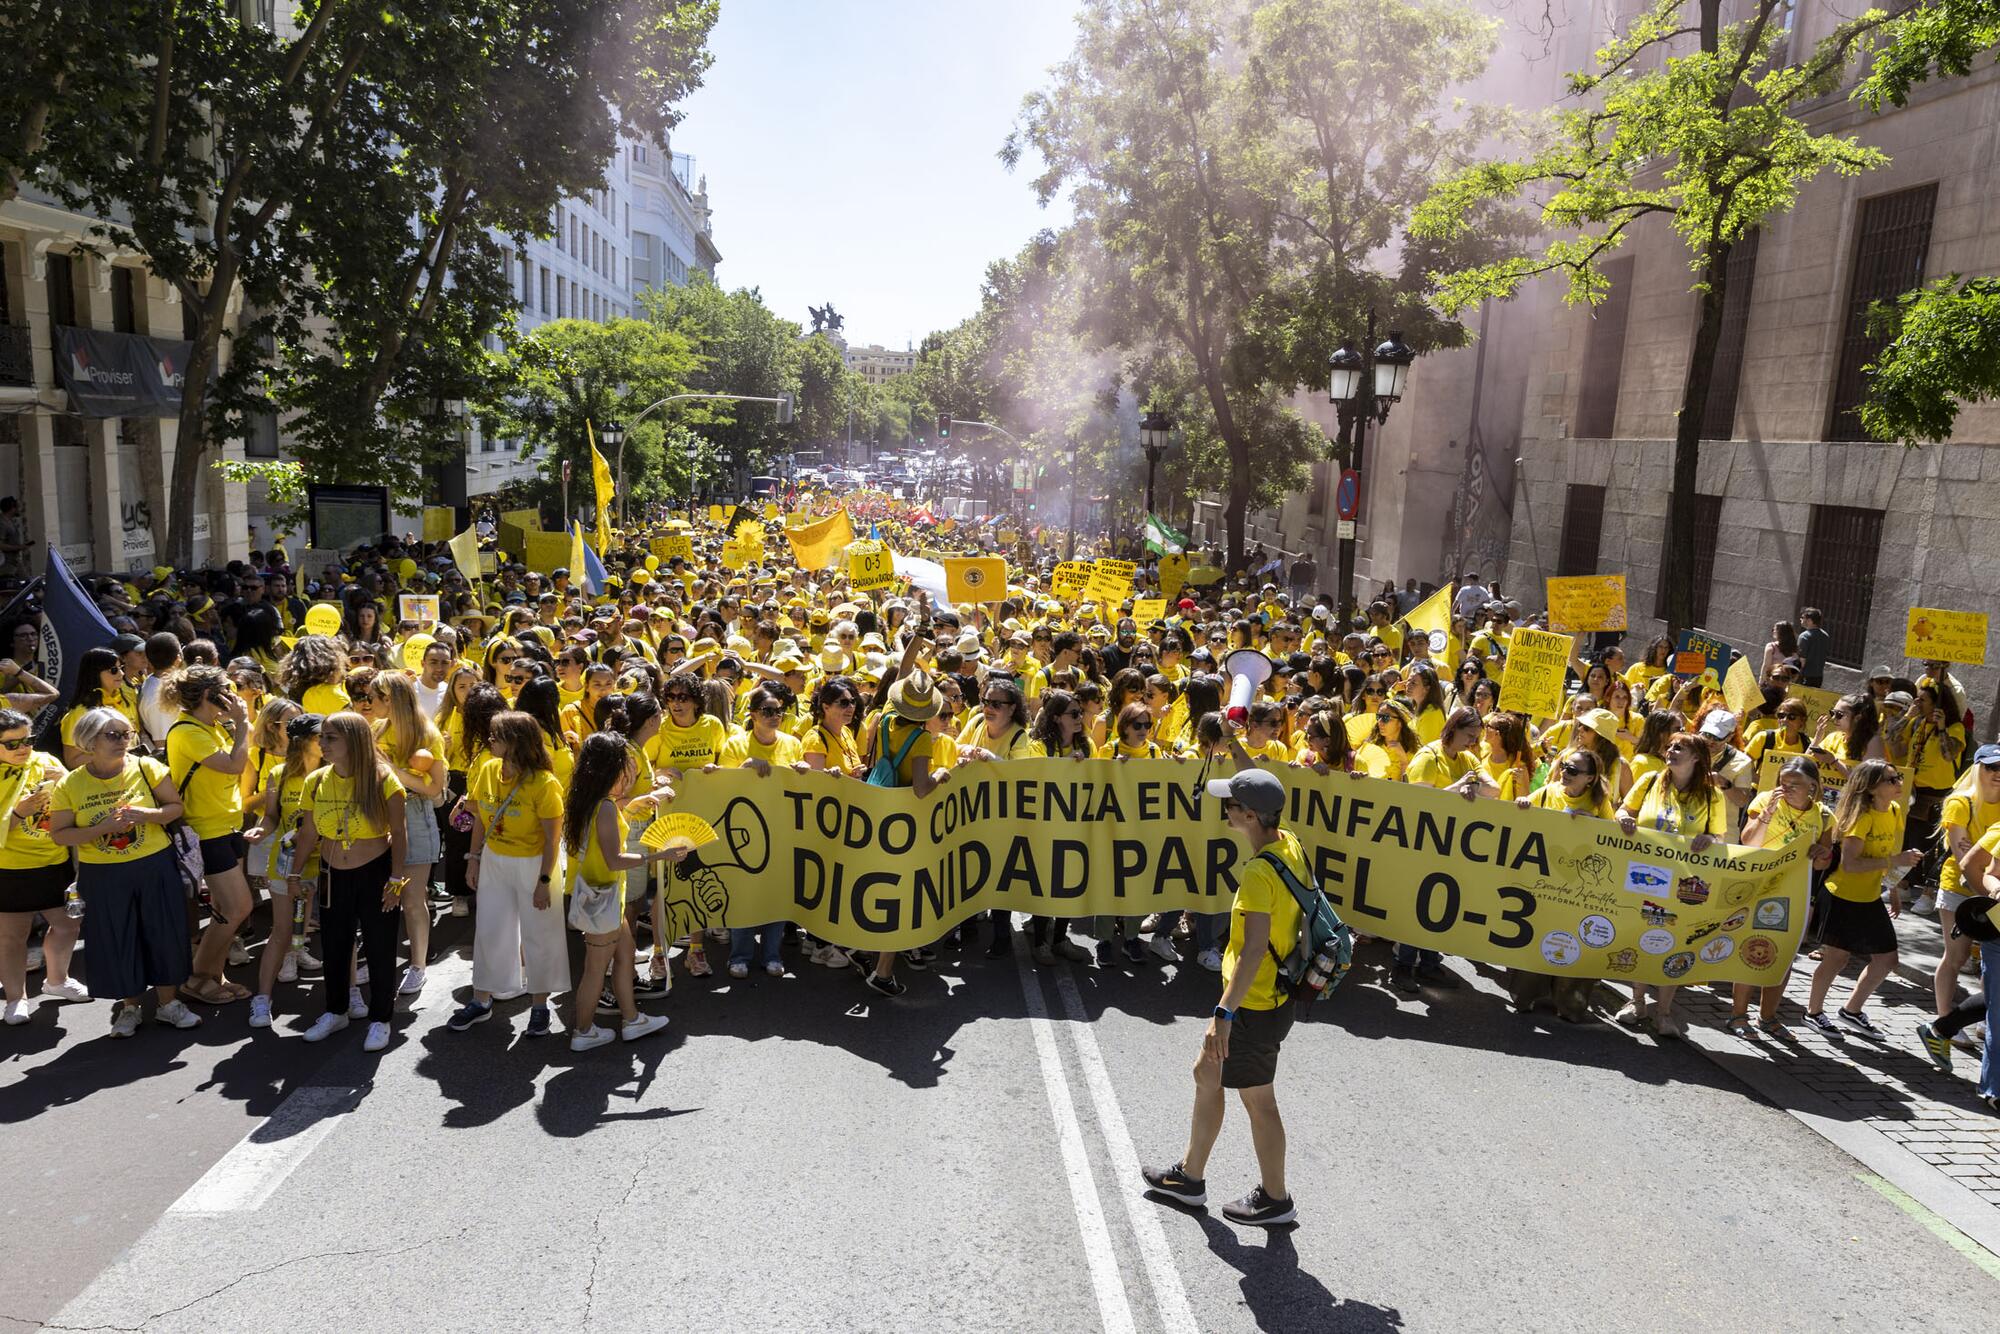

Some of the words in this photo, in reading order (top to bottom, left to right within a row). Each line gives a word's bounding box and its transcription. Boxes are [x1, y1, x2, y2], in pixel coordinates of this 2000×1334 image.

[89, 366, 134, 385] Proviser
[865, 554, 880, 572] 0-3
[1058, 562, 1074, 570] NO
[1101, 559, 1134, 570] EDUCANDO
[1513, 630, 1564, 652] CUIDAMOS
[1687, 638, 1720, 660] PEPE
[1943, 648, 1953, 659] LA
[670, 747, 713, 758] AMARILLA
[783, 789, 918, 856] TODO
[929, 779, 1126, 844] COMIENZA
[1138, 781, 1201, 822] EN
[1290, 786, 1551, 876] INFANCIA
[1596, 834, 1652, 855] UNIDAS
[1654, 846, 1710, 867] SOMOS
[1712, 855, 1747, 873] MÁS
[1750, 850, 1797, 873] FUERTES
[793, 835, 1090, 934] DIGNIDAD
[1112, 836, 1243, 897] PAR
[1314, 845, 1388, 920] EL
[1415, 872, 1537, 949] 0-3
[1583, 903, 1619, 916] ESTATAL
